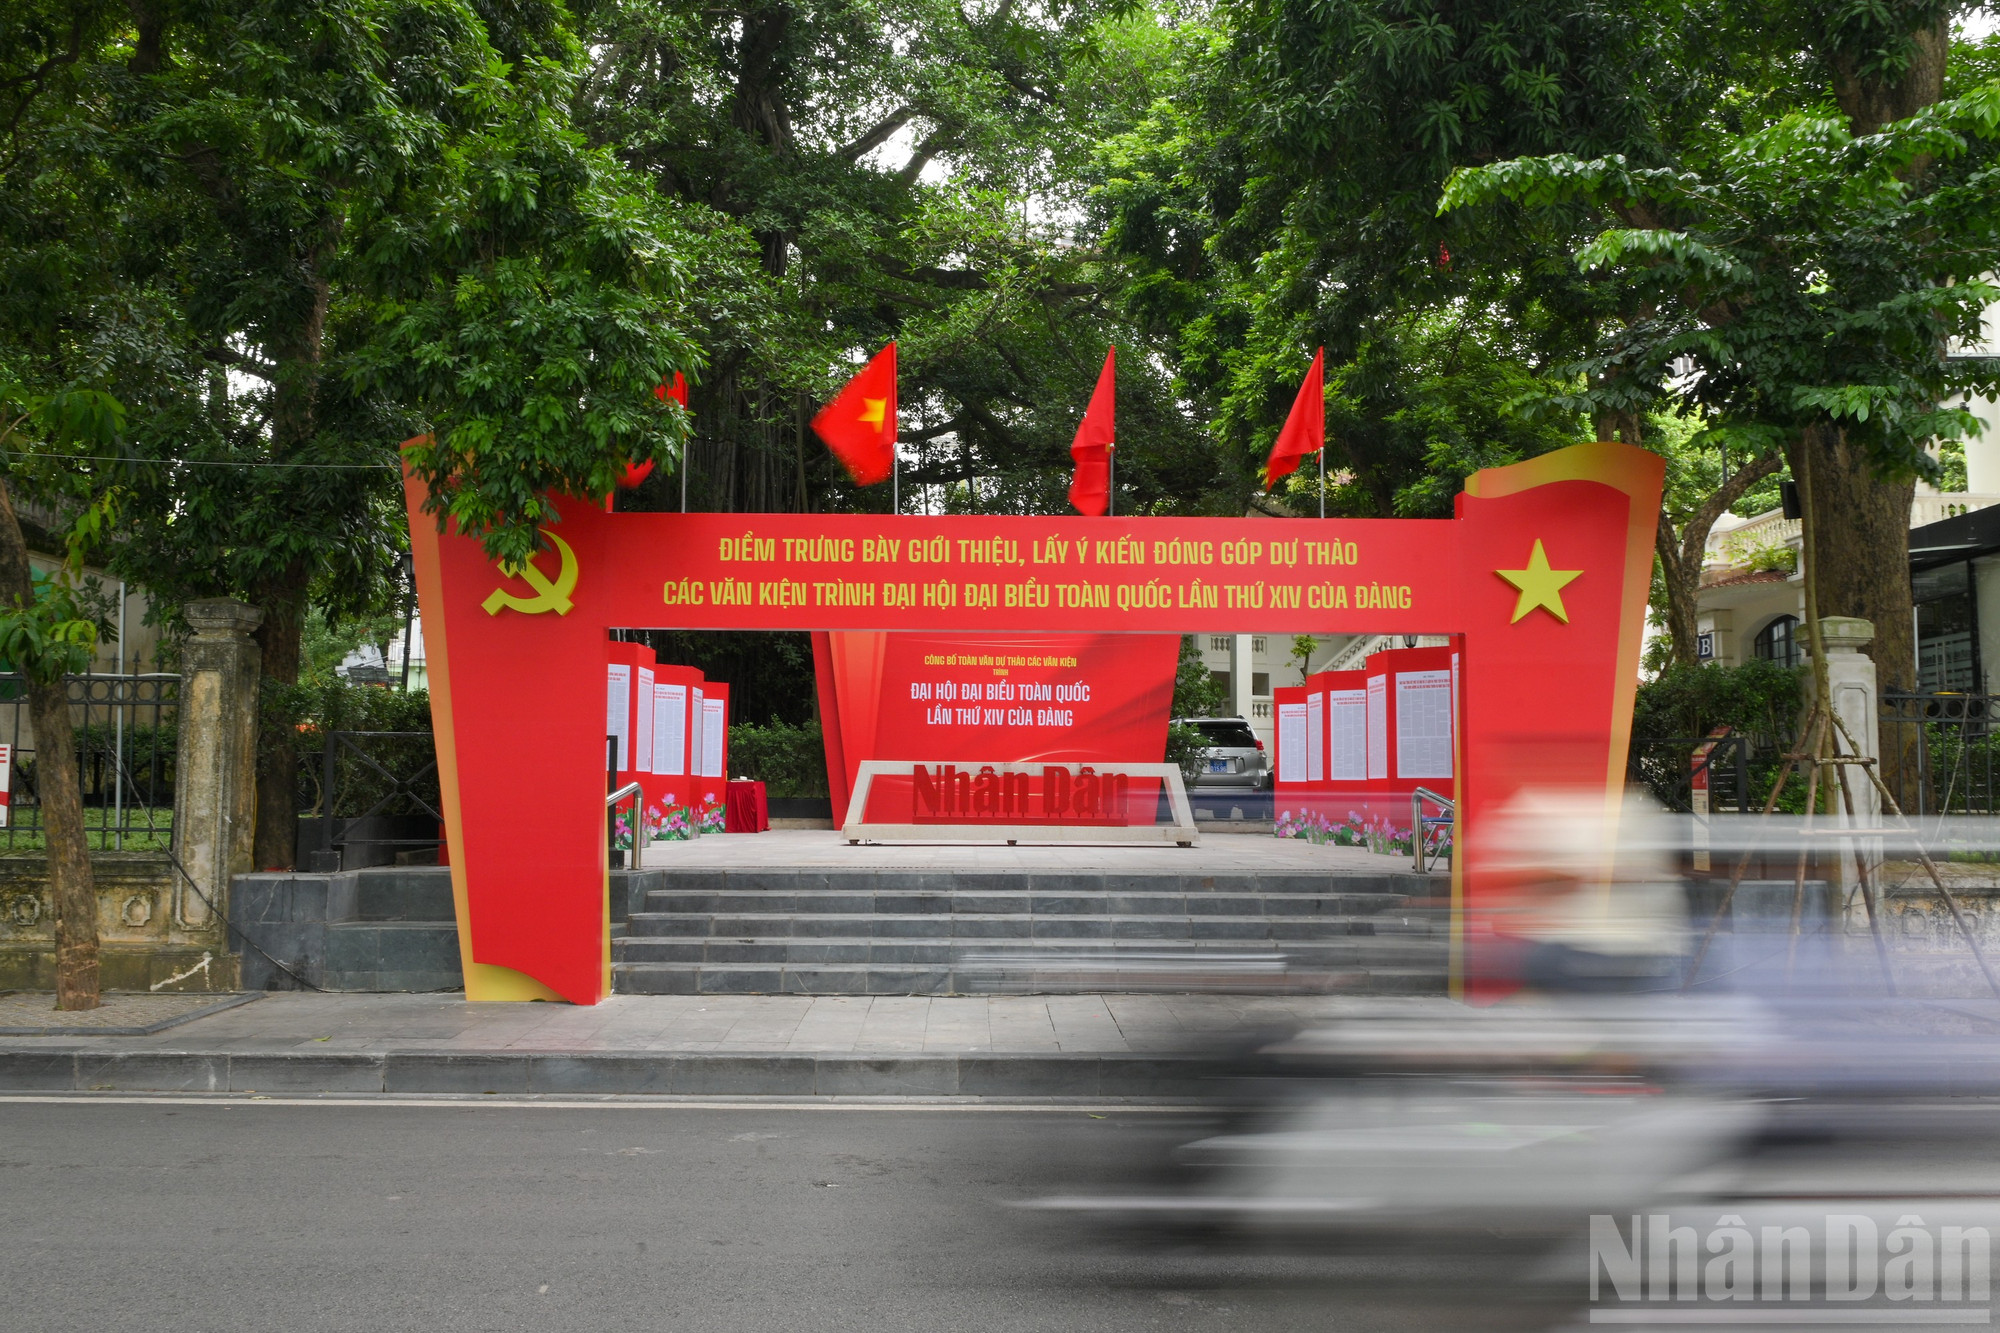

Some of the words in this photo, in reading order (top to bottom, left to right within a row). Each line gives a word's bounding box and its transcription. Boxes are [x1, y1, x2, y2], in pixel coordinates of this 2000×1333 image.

[718, 531, 775, 562] ĐIỂM
[782, 534, 855, 562] TRƯNG
[862, 534, 901, 562] BÀY
[908, 535, 951, 563] GIỚI
[957, 536, 1025, 567] THIỆU,
[1032, 534, 1069, 564] LẤY
[1076, 537, 1089, 564] Ý
[1096, 534, 1145, 564] KIẾN
[1153, 537, 1213, 565] ĐÓNG
[1220, 538, 1263, 565] GÓP
[1270, 538, 1298, 569] DỰ
[1304, 538, 1358, 565] THẢO
[663, 577, 704, 605] CÁC
[709, 577, 752, 605] VĂN
[759, 578, 807, 609] KIỆN
[812, 578, 875, 606] TRÌNH
[882, 582, 916, 610] ĐẠI
[923, 579, 957, 610] HỘI
[964, 583, 998, 611] ĐẠI
[1004, 576, 1050, 608] BIỂU
[1055, 580, 1110, 608] TOÀN
[1116, 577, 1172, 612] QUỐC
[1178, 578, 1219, 609] LẦN
[1223, 581, 1265, 609] THỨ
[1269, 585, 1302, 609] XIV
[1307, 580, 1349, 609] CỦA
[1354, 581, 1412, 609] ĐẢNG
[1700, 638, 1711, 656] B
[924, 654, 945, 665] CÔNG
[946, 653, 957, 665] BỐ
[958, 654, 977, 666] TOÀN
[979, 655, 994, 666] VĂN
[995, 655, 1006, 667] DỰ
[1007, 655, 1026, 667] THẢO
[1027, 656, 1042, 667] CÁC
[1043, 656, 1058, 667] VĂN
[1059, 656, 1077, 668] KIỆN
[910, 682, 932, 702] ĐẠI
[935, 680, 957, 702] HỘI
[961, 683, 982, 702] ĐẠI
[986, 678, 1015, 701] BIỂU
[1018, 681, 1052, 701] TOÀN
[1055, 680, 1091, 704] QUỐC
[927, 703, 952, 725] LẦN
[955, 705, 981, 725] THỨ
[983, 708, 1004, 726] XIV
[1007, 706, 1034, 726] CỦA
[1037, 706, 1073, 727] ĐẢNG
[913, 764, 1030, 813] Nhân
[1043, 765, 1129, 814] Dân
